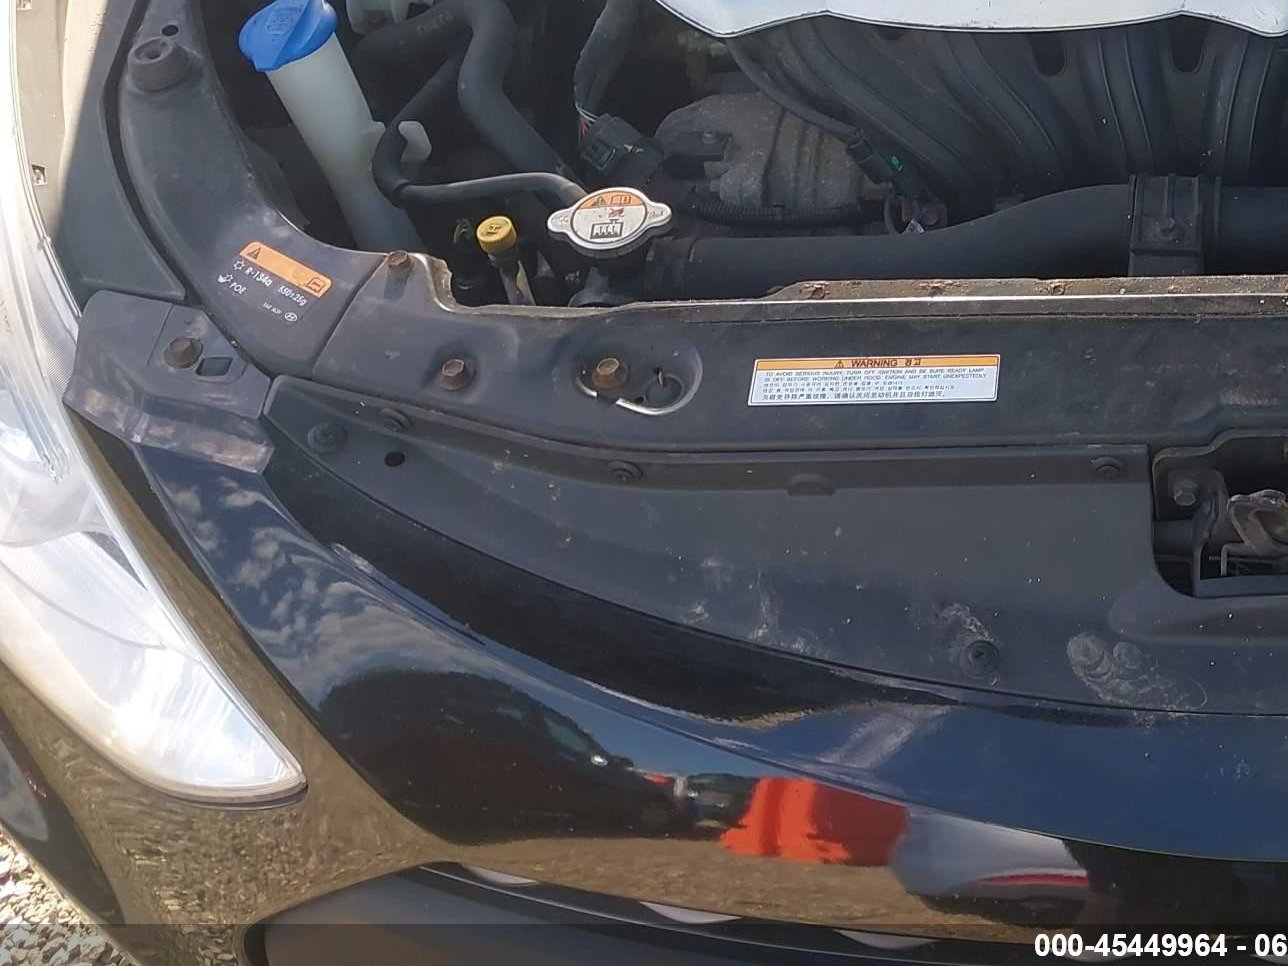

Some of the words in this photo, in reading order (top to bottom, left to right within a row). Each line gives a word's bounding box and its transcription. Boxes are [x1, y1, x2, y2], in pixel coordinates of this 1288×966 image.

[244, 266, 273, 287] R-134a
[229, 282, 248, 295] POE
[851, 359, 898, 368] WARNING
